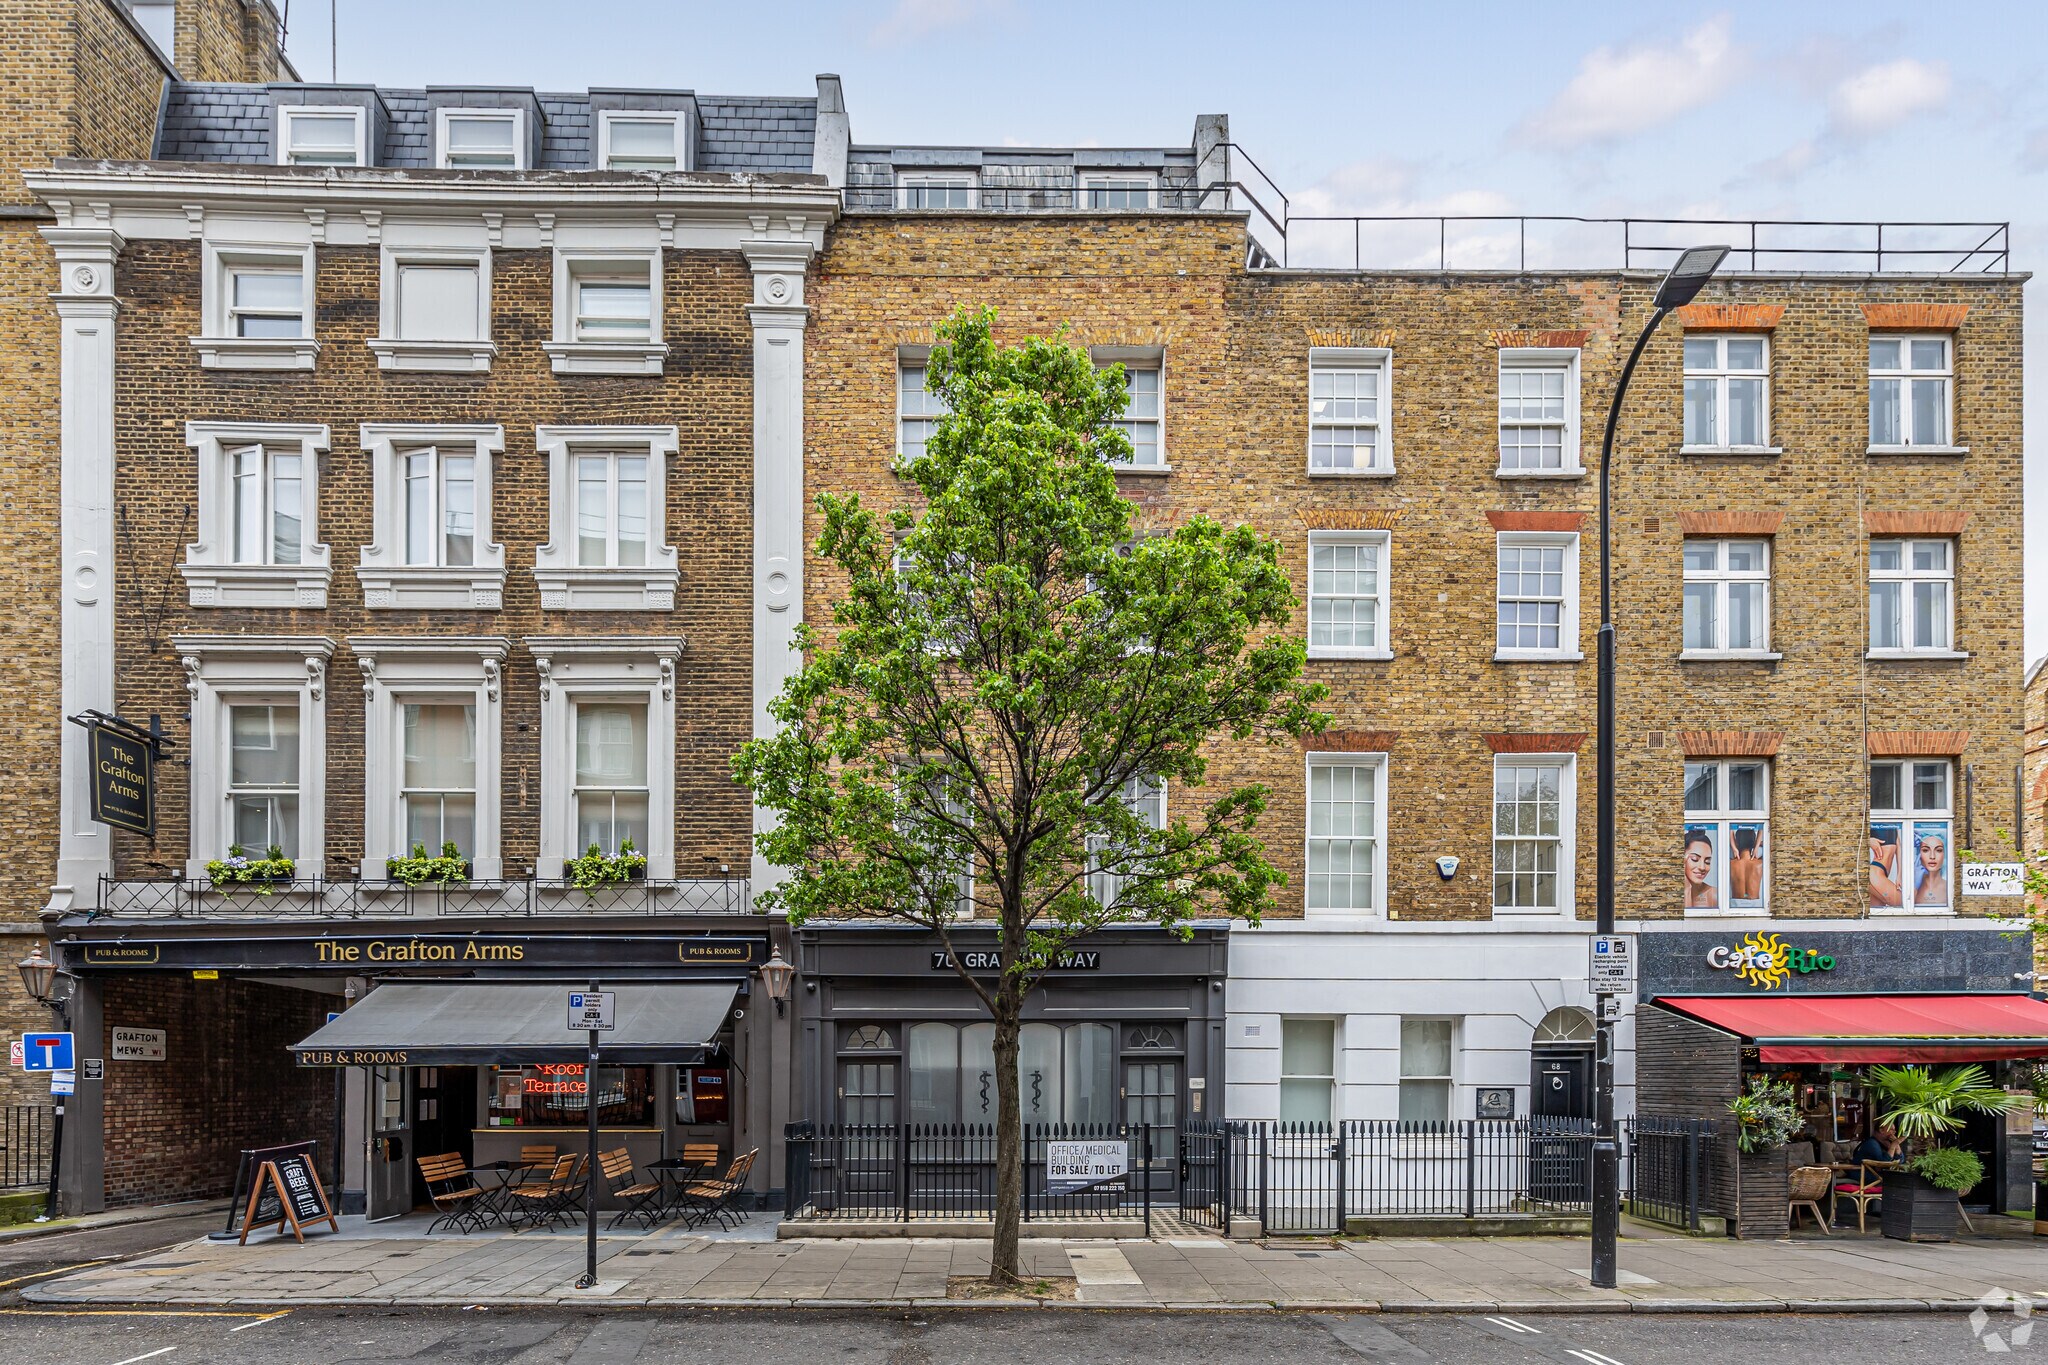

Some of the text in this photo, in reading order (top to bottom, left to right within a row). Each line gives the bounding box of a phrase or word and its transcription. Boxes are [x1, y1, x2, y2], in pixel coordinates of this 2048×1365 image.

[111, 746, 134, 765] The
[100, 760, 145, 786] Grafton
[109, 780, 139, 800] Arms
[1967, 868, 2018, 877] GRAFTON
[1968, 881, 1992, 890] WAY
[112, 948, 120, 956] &
[314, 939, 524, 961] The Grafton Arms
[706, 947, 713, 955] &
[965, 953, 1047, 968] GRAN
[1057, 952, 1097, 968] WAY
[1706, 945, 1837, 974] Cafe Rio
[116, 1032, 158, 1043] GRAFTON
[116, 1046, 144, 1055] MEWS
[302, 1050, 408, 1064] PUB & ROOMS
[523, 1078, 588, 1093] Terrace
[1051, 1155, 1090, 1165] BUILDING
[285, 1167, 304, 1180] CRAFT
[1051, 1165, 1067, 1175] FOR
[1107, 1165, 1121, 1175] LET
[288, 1176, 309, 1189] BEER
